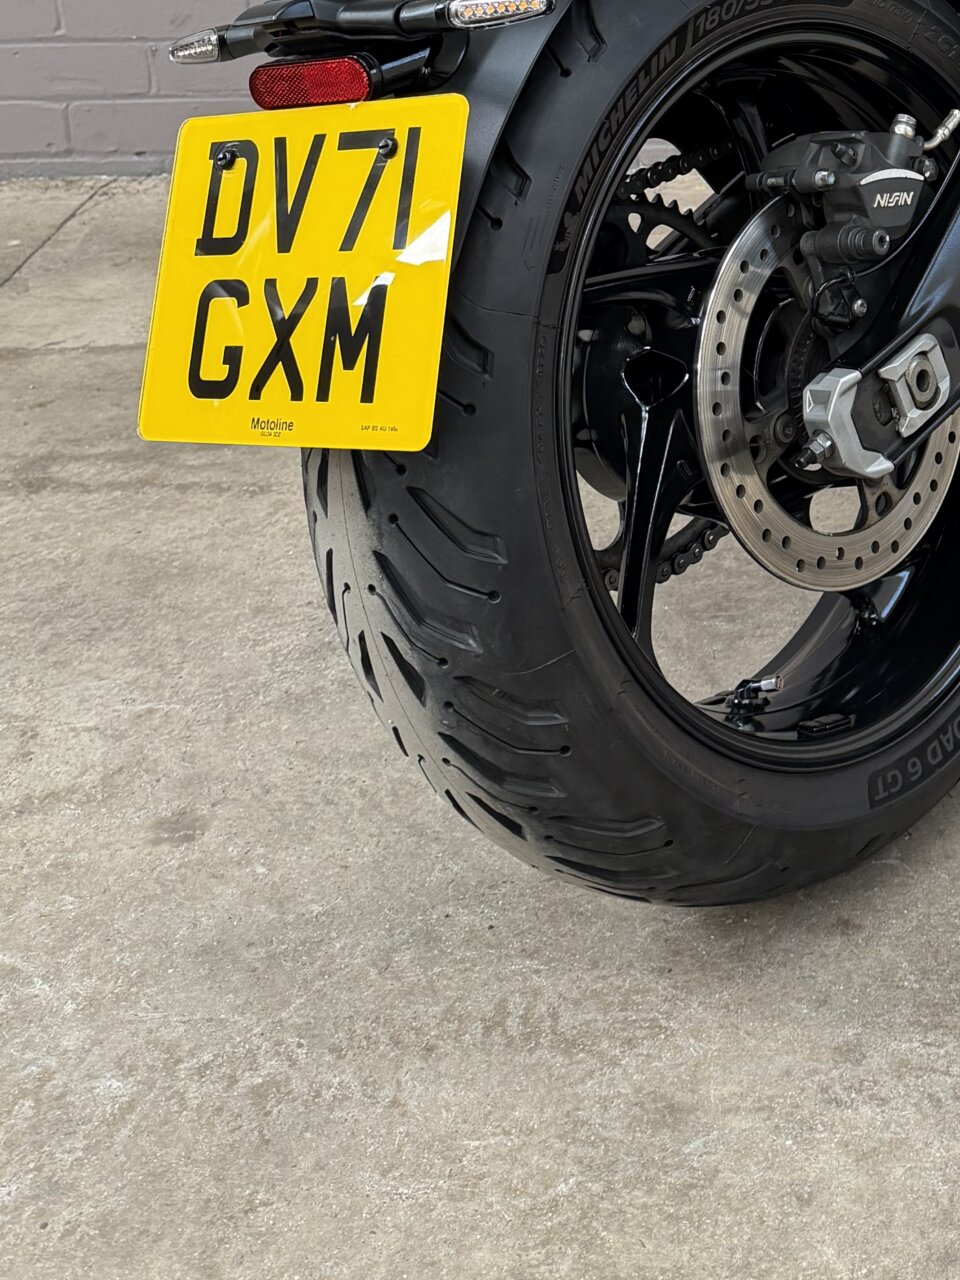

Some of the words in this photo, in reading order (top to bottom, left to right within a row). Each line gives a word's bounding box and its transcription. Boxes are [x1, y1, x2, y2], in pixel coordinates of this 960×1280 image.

[574, 37, 678, 204] MICHELIN
[195, 127, 422, 256] DV71
[188, 276, 389, 404] GXM
[250, 417, 294, 431] Motoline
[874, 770, 904, 801] GT
[907, 755, 924, 781] 6
